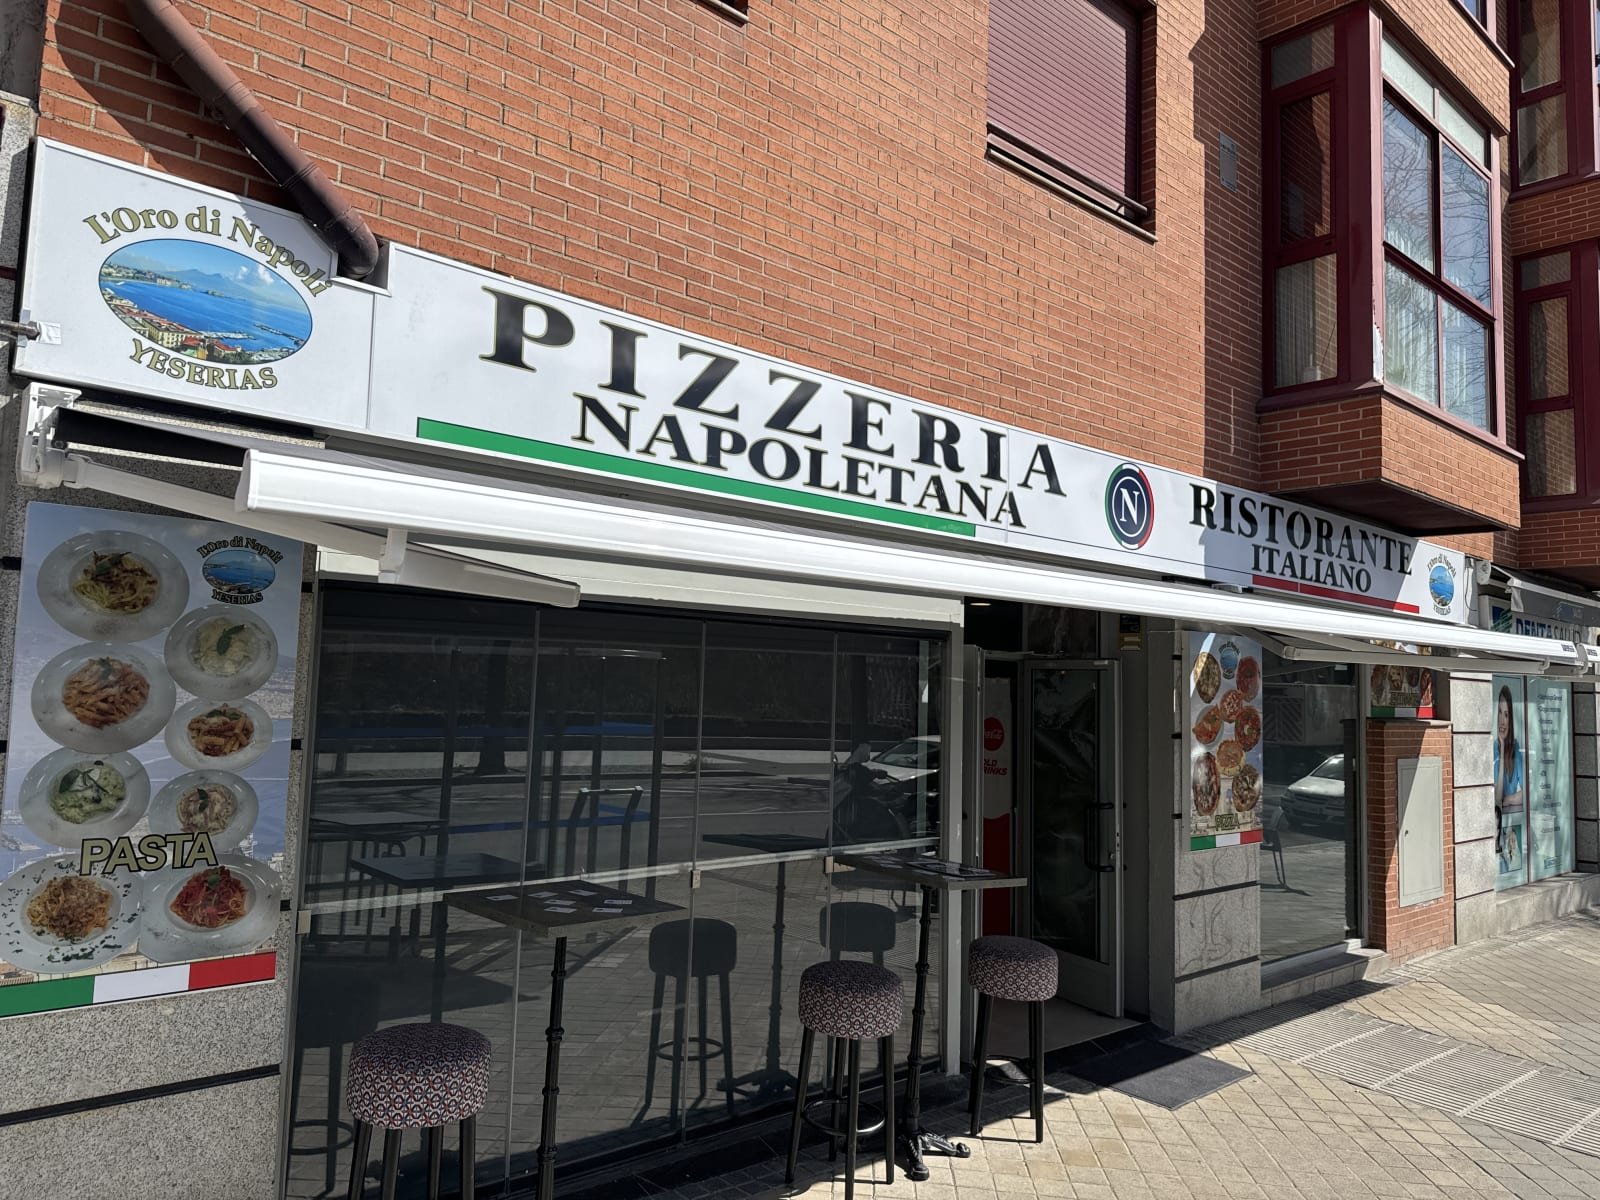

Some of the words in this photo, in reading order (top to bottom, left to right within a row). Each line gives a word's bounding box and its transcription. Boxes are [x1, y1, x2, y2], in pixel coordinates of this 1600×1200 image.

[83, 206, 177, 245] L'Oro
[185, 206, 221, 237] di
[227, 216, 333, 297] Napoli
[129, 338, 279, 390] YESERIAS
[479, 285, 1067, 497] PIZZERIA
[571, 392, 1026, 528] NAPOLETANA
[1120, 488, 1141, 526] N
[1189, 483, 1412, 575] RISTORANTE
[230, 536, 243, 548] di
[245, 538, 284, 564] Napoli
[1252, 544, 1371, 593] ITALIANO
[984, 758, 997, 767] OLD
[984, 767, 1008, 776] RINKS
[1215, 813, 1240, 831] PIZZA
[80, 832, 218, 876] PASTA
